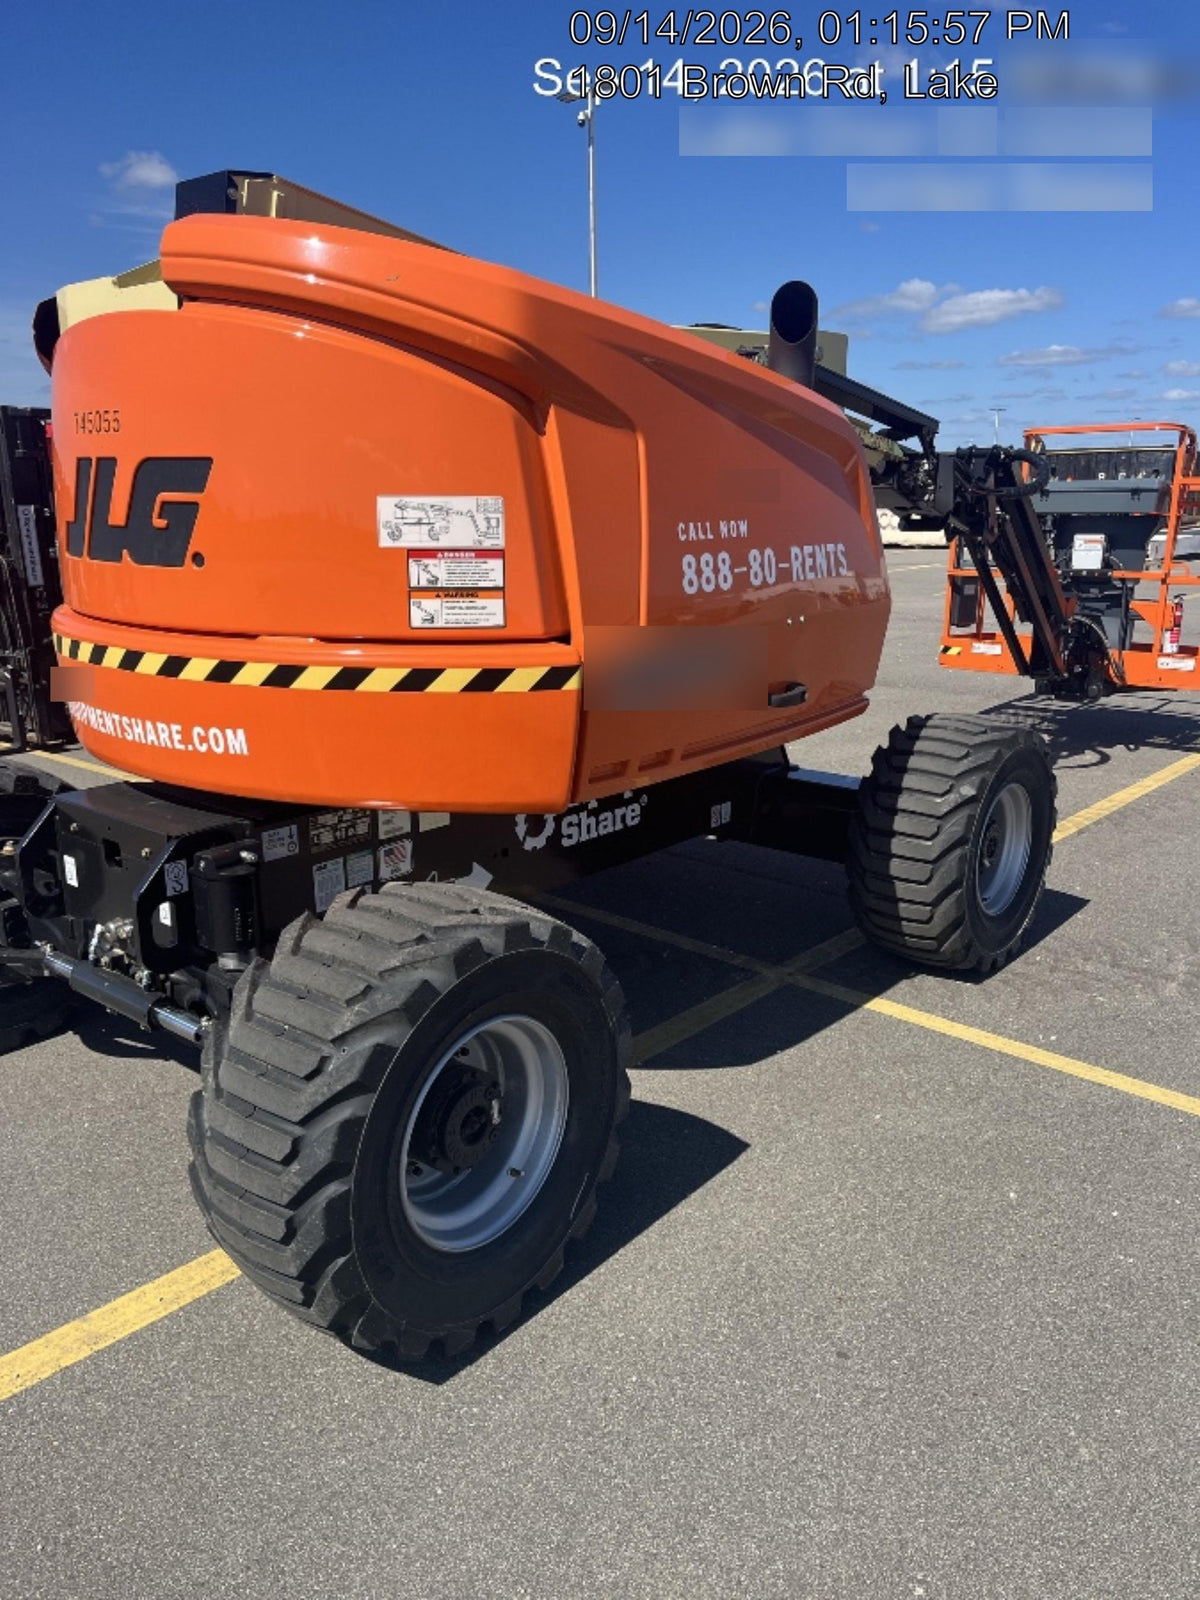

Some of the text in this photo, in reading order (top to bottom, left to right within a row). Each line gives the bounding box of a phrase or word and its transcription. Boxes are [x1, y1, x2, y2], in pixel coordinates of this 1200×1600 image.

[73, 410, 121, 434] 145055
[678, 519, 748, 541] CALL NOW
[682, 543, 848, 595] 888-80-RENTS
